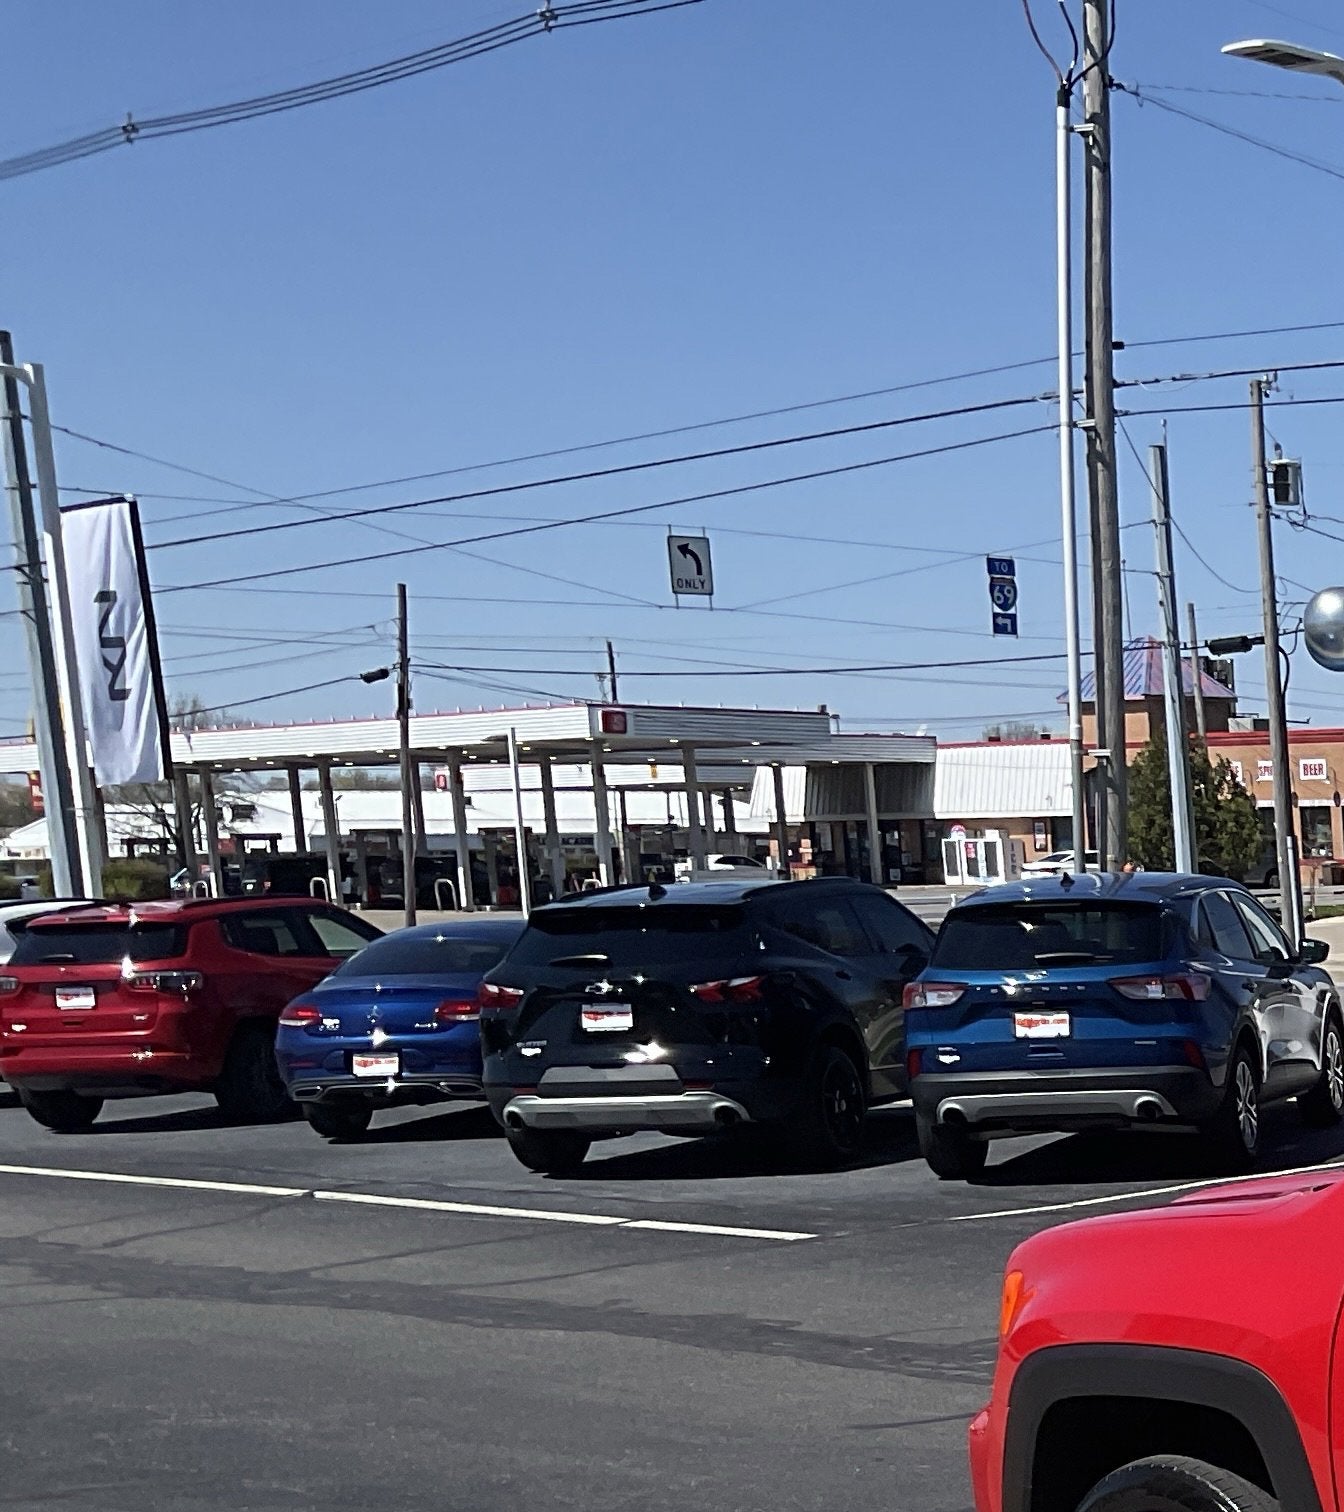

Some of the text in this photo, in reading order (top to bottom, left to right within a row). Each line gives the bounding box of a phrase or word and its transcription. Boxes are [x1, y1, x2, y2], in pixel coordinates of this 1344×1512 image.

[994, 562, 1009, 572] TO
[676, 577, 706, 590] ONLY
[993, 585, 1015, 605] 69
[1302, 763, 1325, 776] BEER
